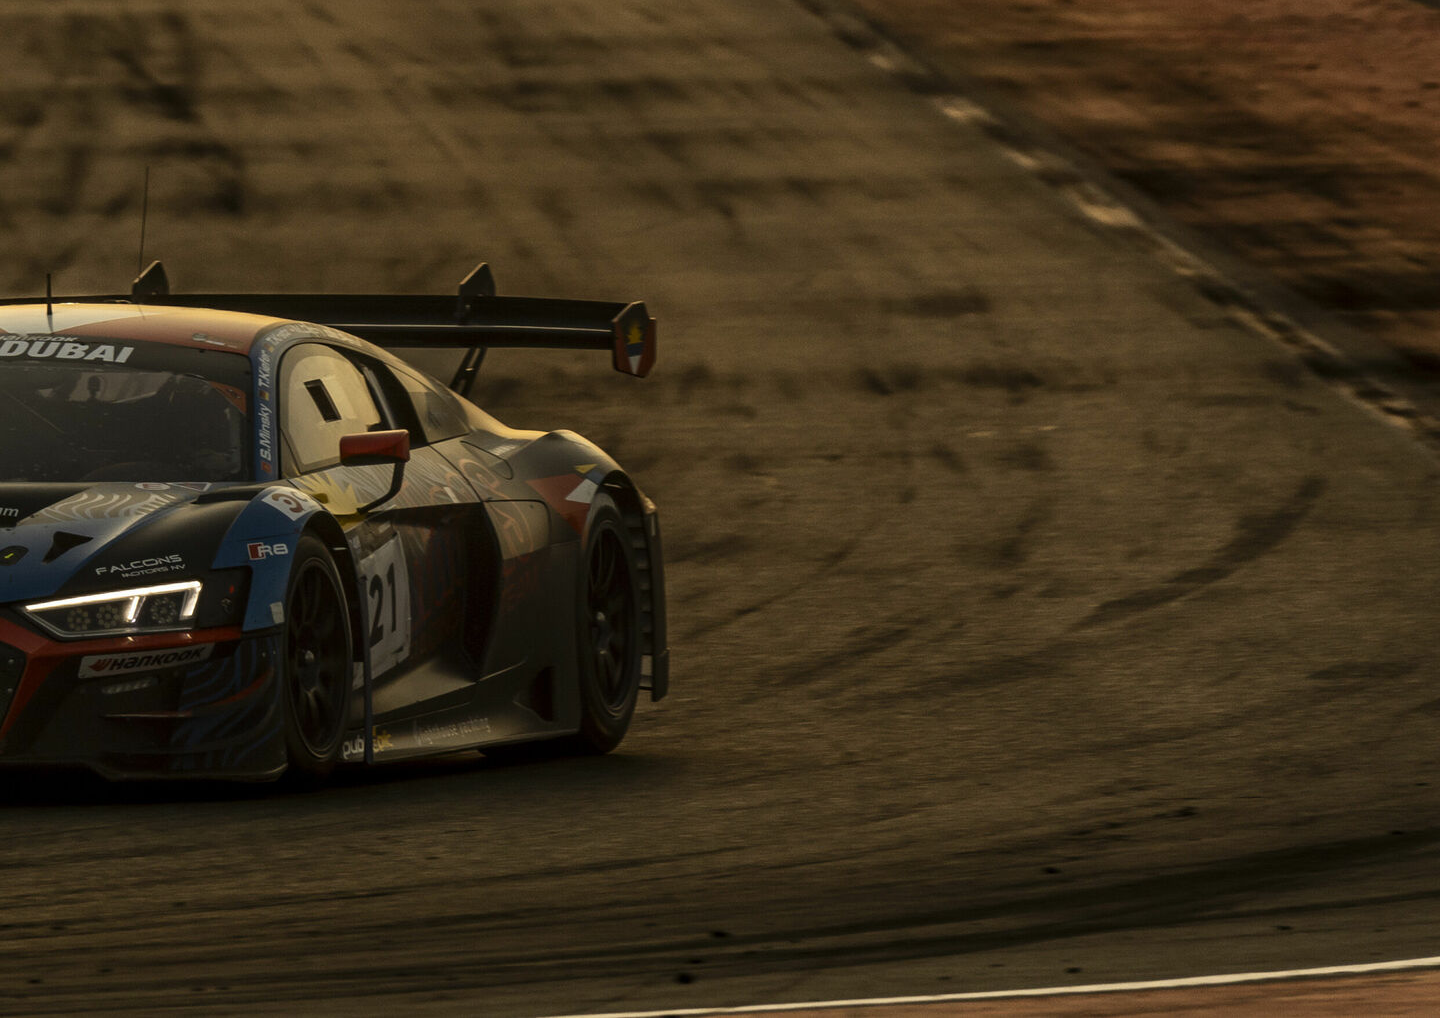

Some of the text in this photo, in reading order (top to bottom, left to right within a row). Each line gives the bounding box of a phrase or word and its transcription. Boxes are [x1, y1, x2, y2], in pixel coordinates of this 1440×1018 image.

[257, 542, 289, 557] R8
[95, 553, 184, 576] FALCONS
[369, 562, 397, 649] 21
